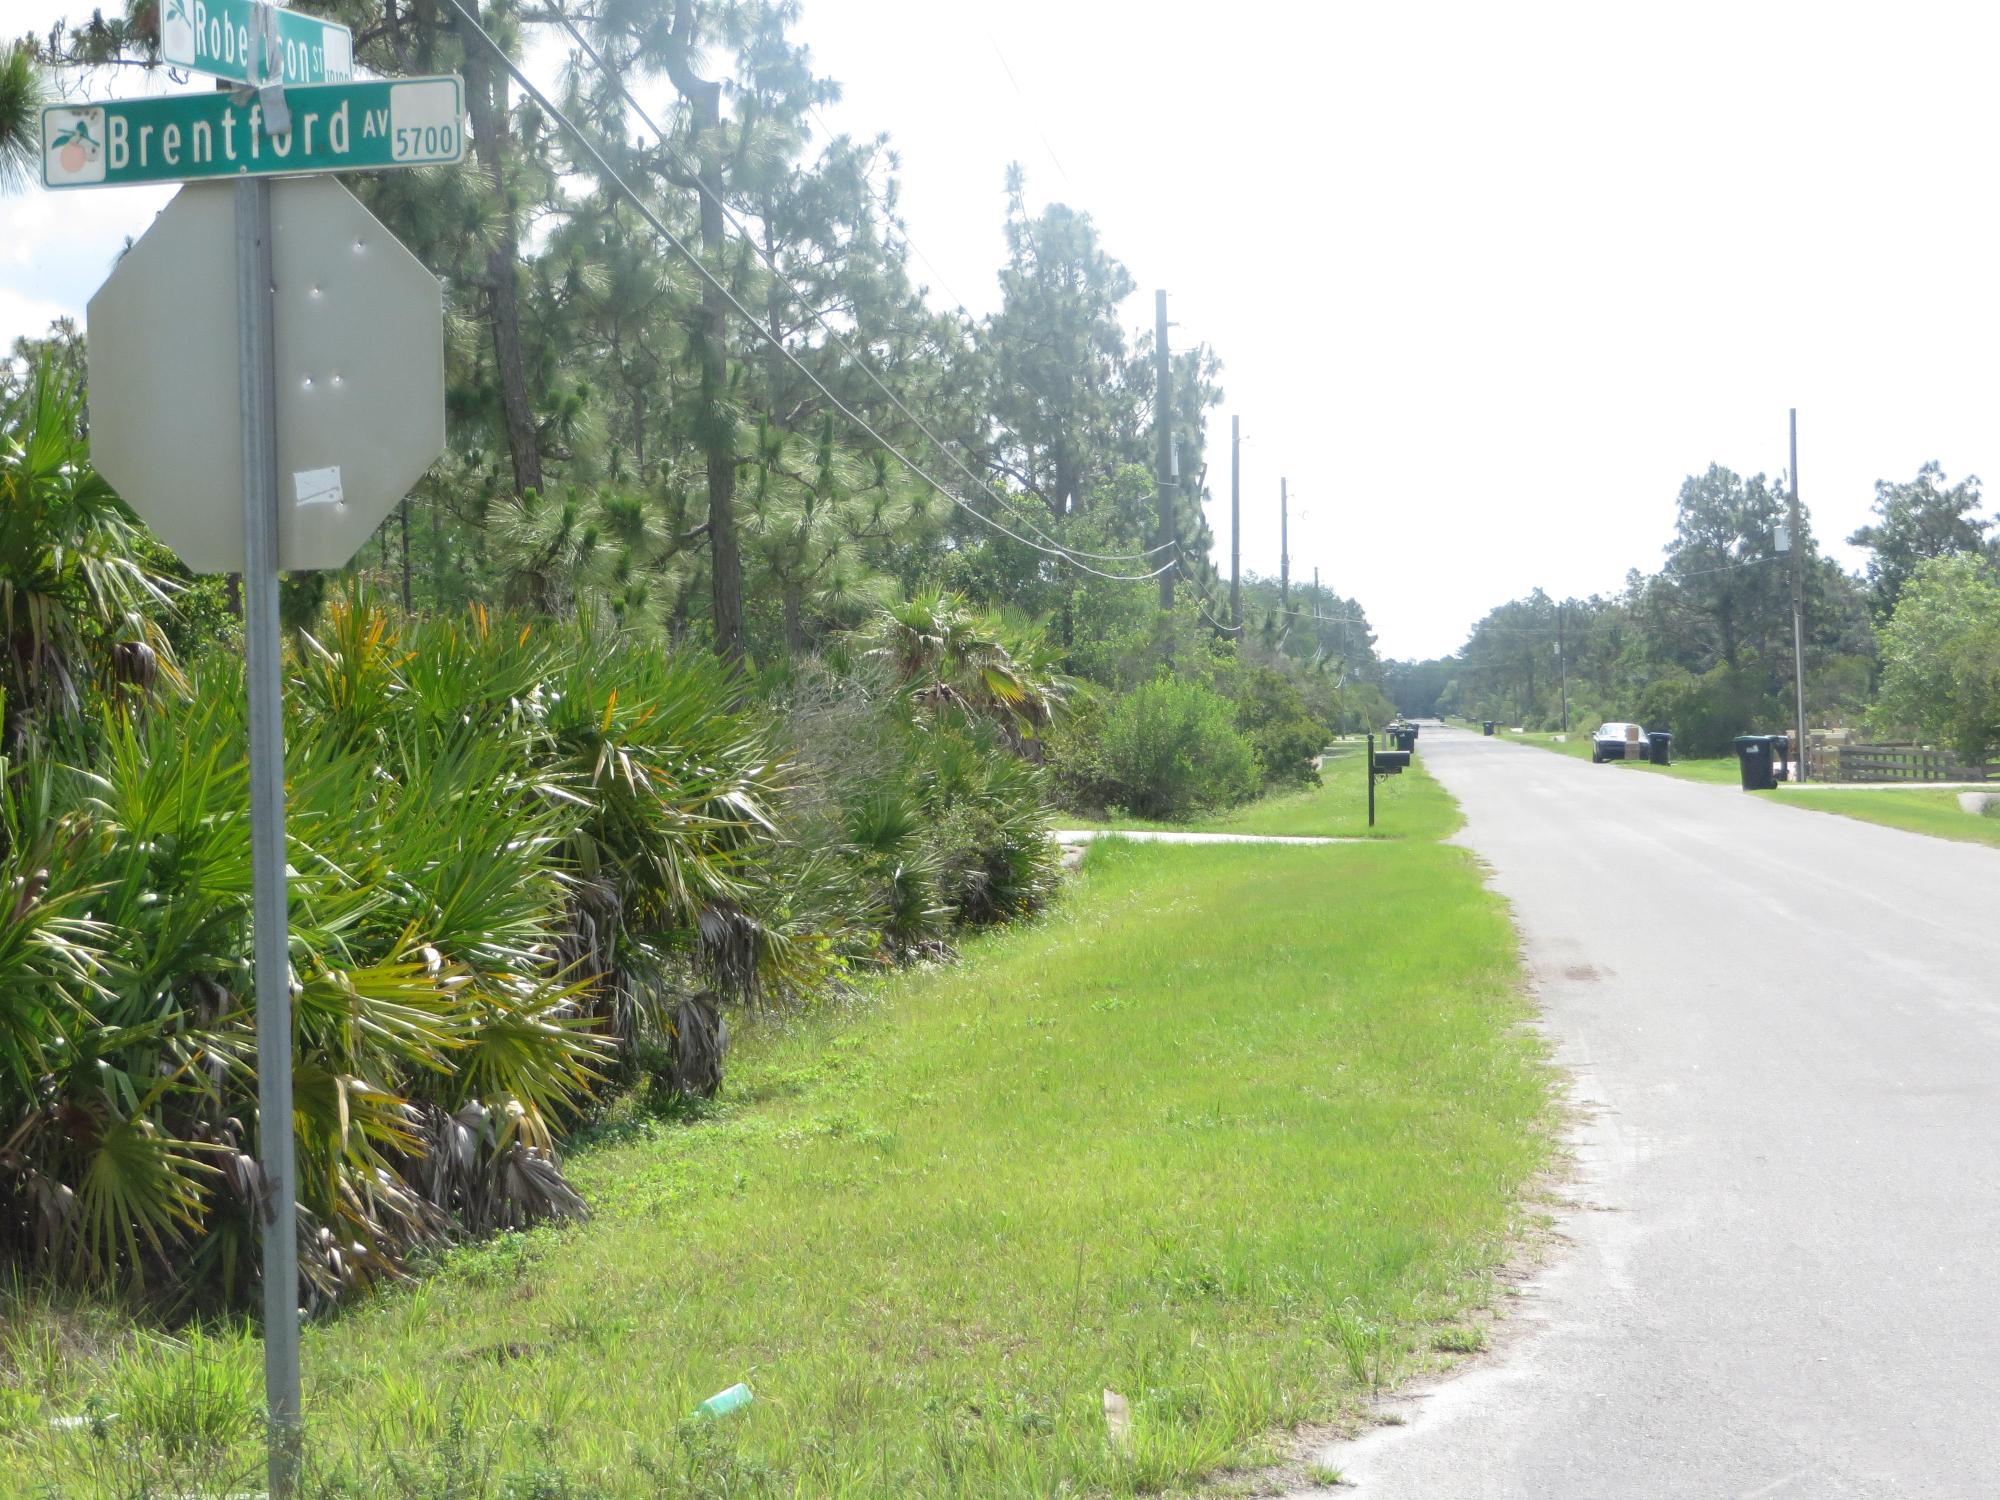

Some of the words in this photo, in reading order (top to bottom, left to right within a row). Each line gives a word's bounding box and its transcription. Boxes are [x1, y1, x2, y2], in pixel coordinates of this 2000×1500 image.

[196, 1, 310, 83] Robeon
[313, 46, 323, 73] ST
[362, 110, 389, 138] AV
[397, 126, 453, 156] 5700
